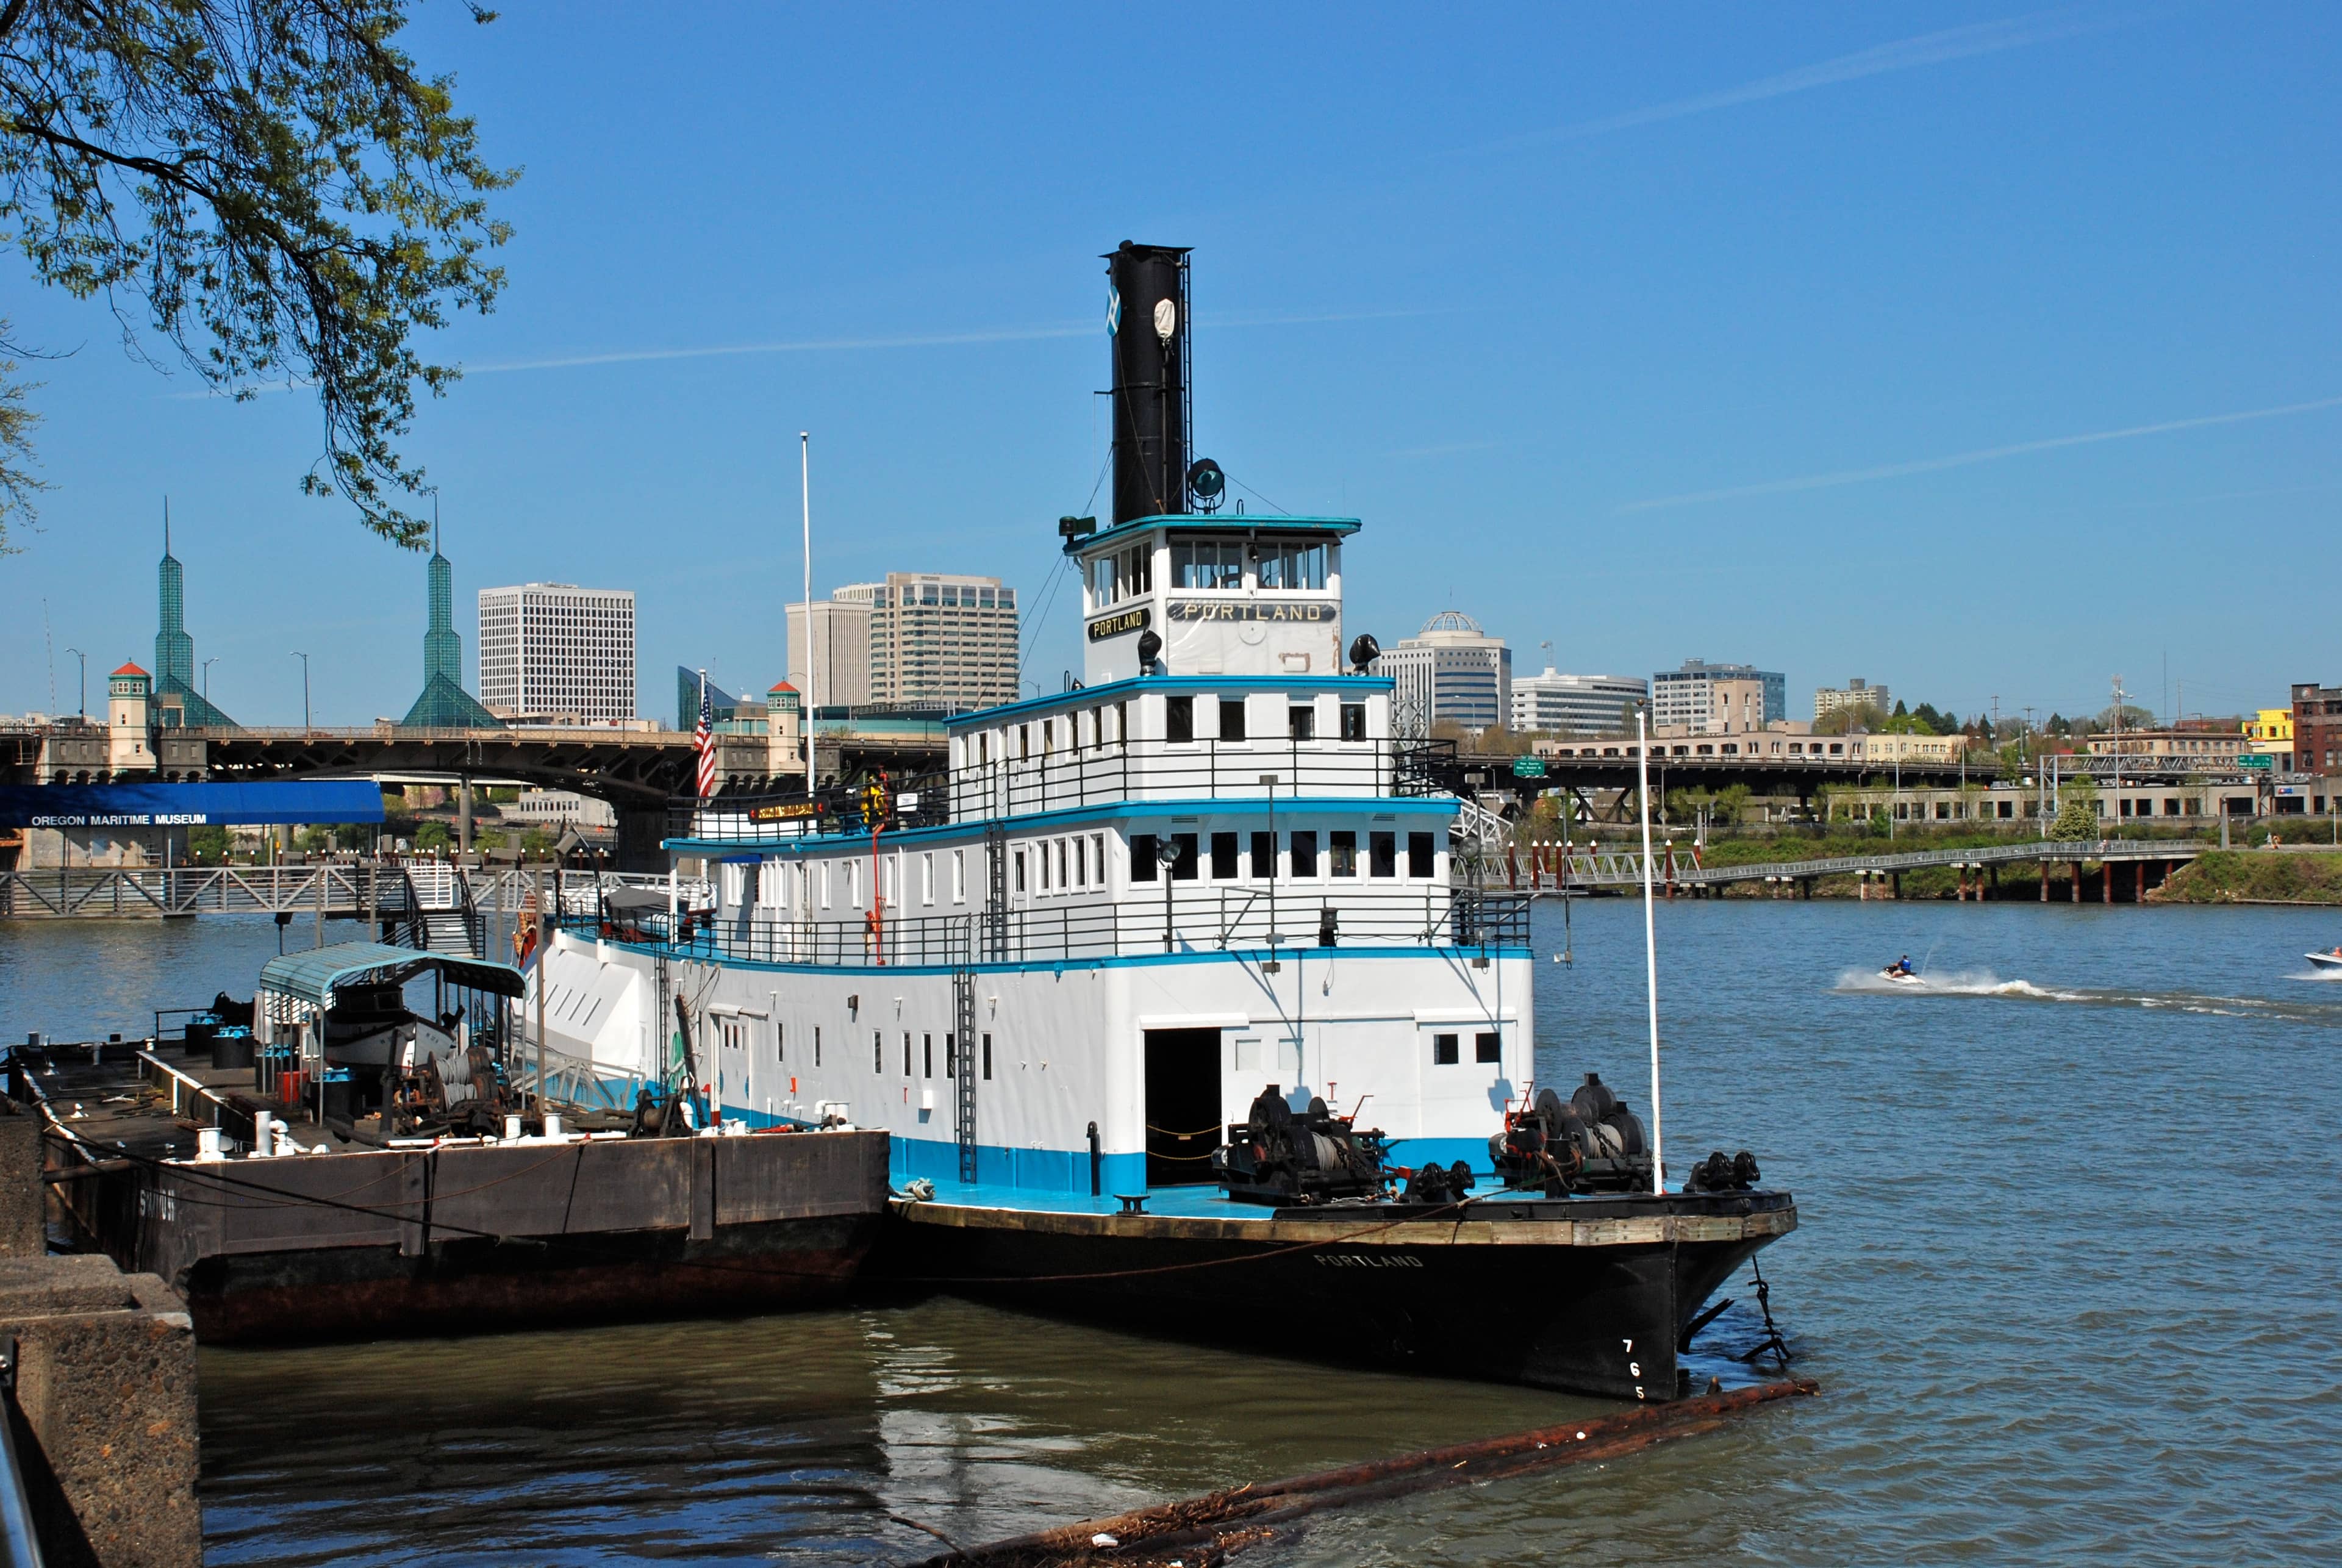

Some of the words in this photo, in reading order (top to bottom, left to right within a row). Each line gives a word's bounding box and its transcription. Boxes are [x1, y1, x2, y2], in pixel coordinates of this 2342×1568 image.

[1184, 604, 1320, 621] PORTLAND
[1094, 611, 1142, 638] PORTLAND
[32, 815, 85, 826] OREGON
[91, 815, 150, 825] MARITIME
[156, 814, 206, 825] MUSEUM
[1312, 1255, 1424, 1267] PORTLAND
[1622, 1339, 1633, 1353] 7
[1630, 1362, 1641, 1376] 6
[1635, 1386, 1645, 1399] 5
